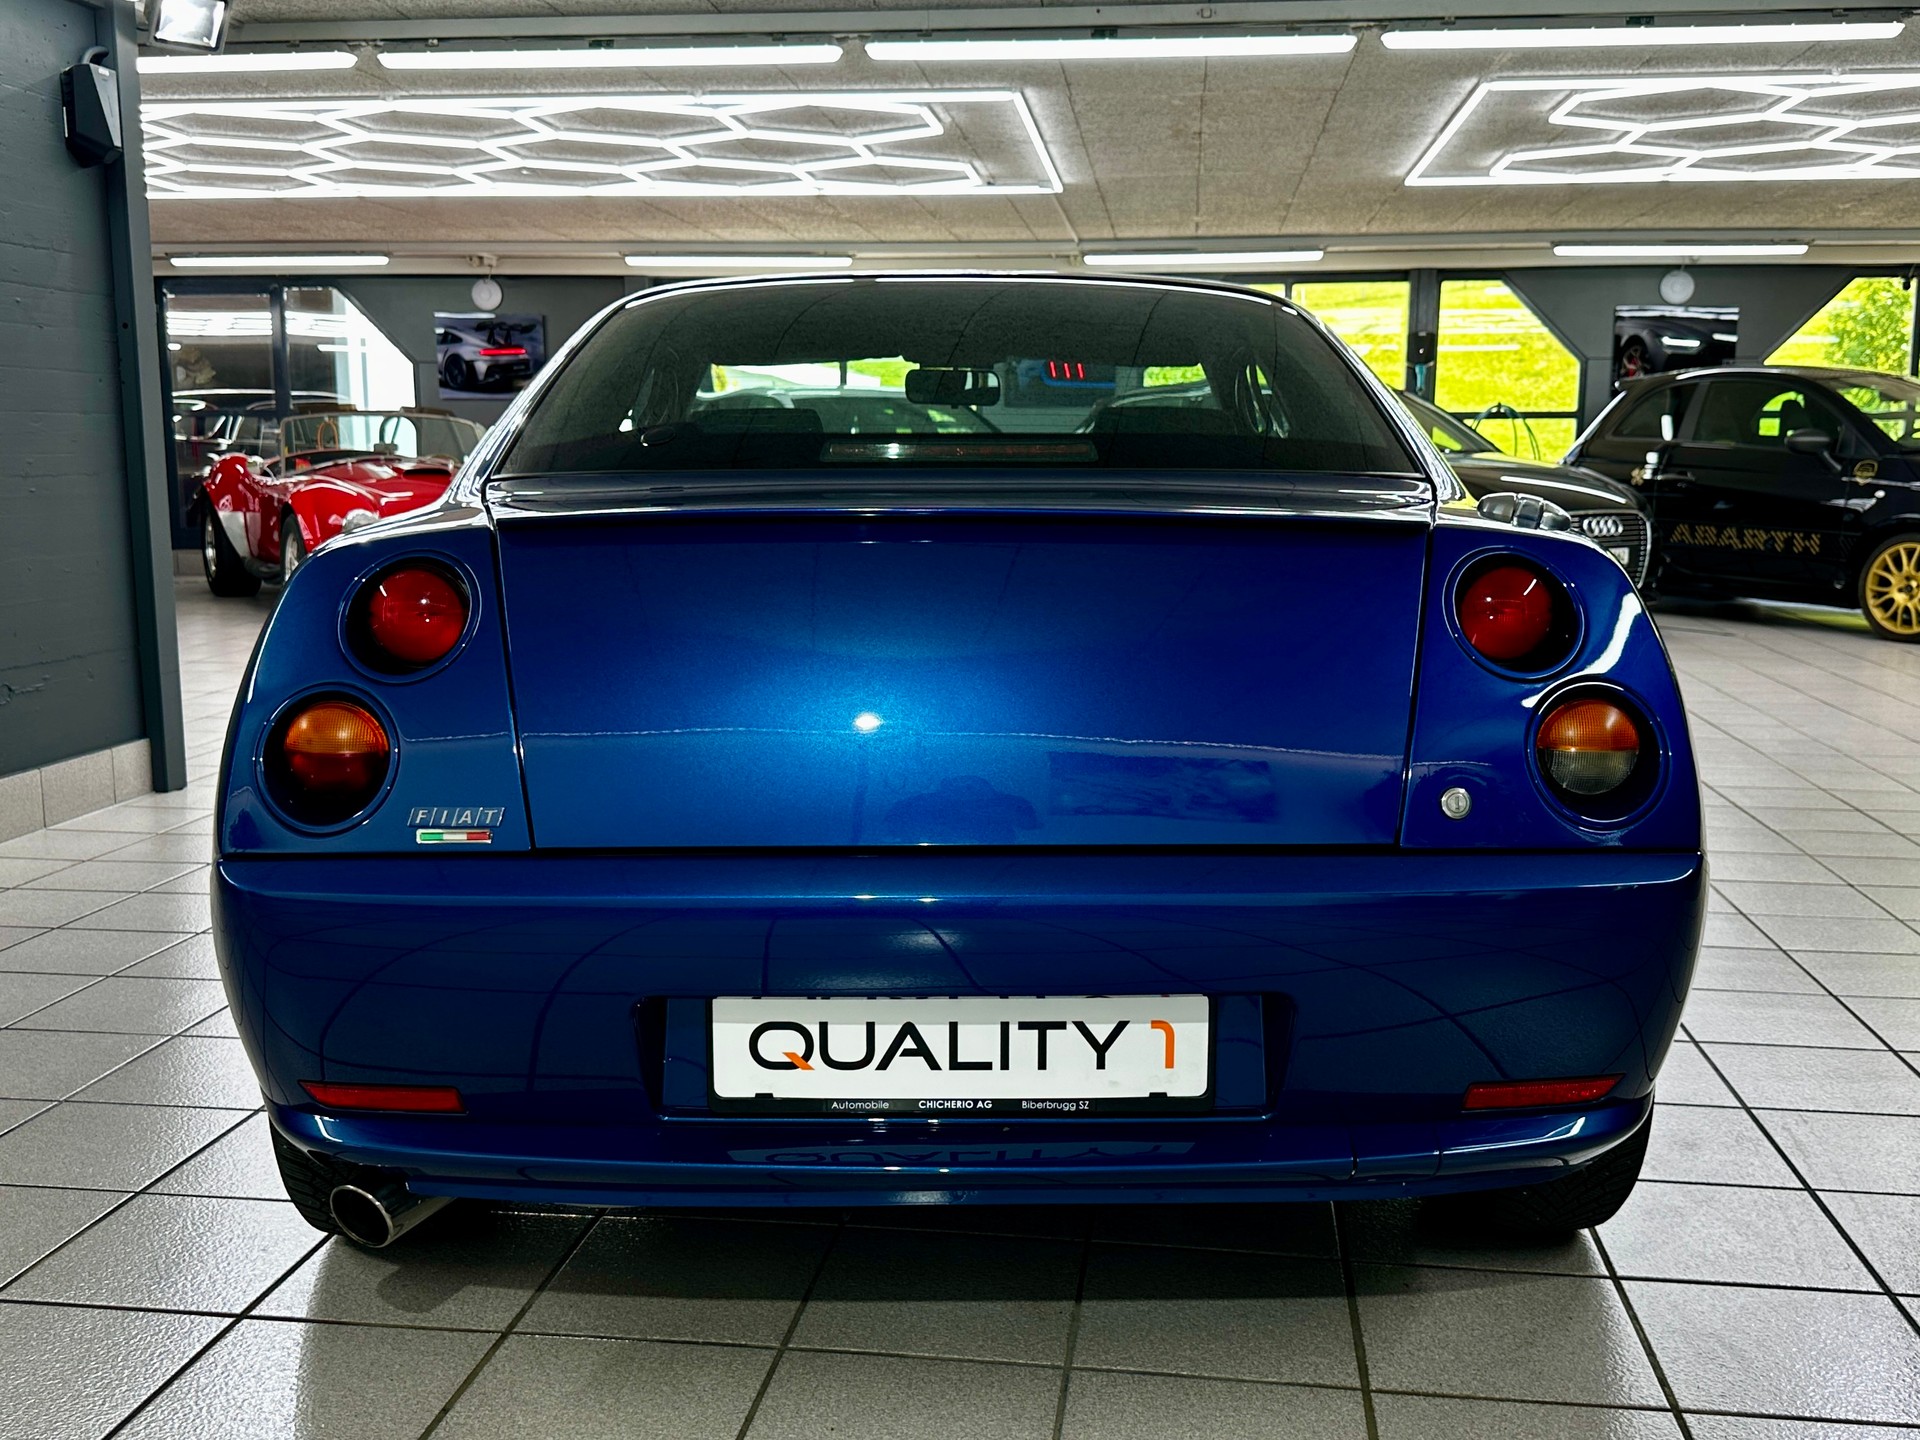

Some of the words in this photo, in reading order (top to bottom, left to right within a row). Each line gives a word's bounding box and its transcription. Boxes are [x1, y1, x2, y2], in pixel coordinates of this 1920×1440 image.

[1670, 523, 1821, 555] ABARTH
[410, 808, 502, 826] FIAT
[748, 1019, 1131, 1071] QUALITY
[1150, 1019, 1175, 1070] 1
[831, 1100, 890, 1110] Automobile
[918, 1100, 974, 1110] CHICHERIO
[976, 1100, 993, 1110] AG
[1021, 1100, 1077, 1111] Biberbrugg
[1078, 1101, 1090, 1110] SZ
